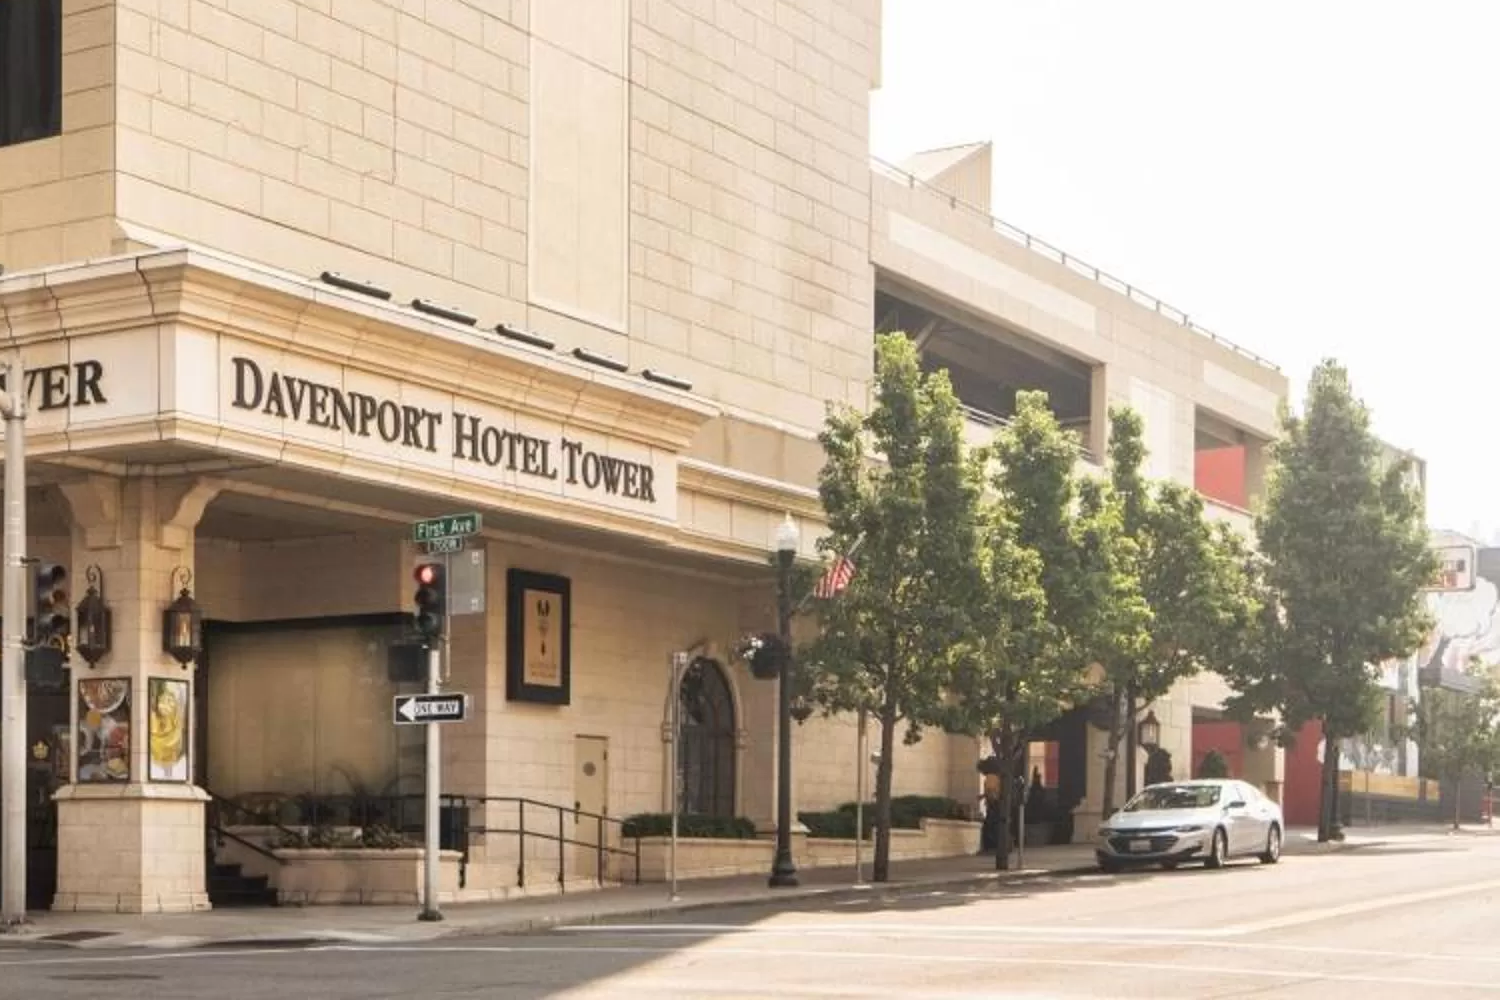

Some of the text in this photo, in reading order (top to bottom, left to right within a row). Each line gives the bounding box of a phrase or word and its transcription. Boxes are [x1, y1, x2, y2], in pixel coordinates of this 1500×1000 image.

[231, 356, 656, 503] DAVENPORT HOTEL TOWER
[417, 518, 473, 538] First Ave
[413, 702, 457, 715] ONE WAY
